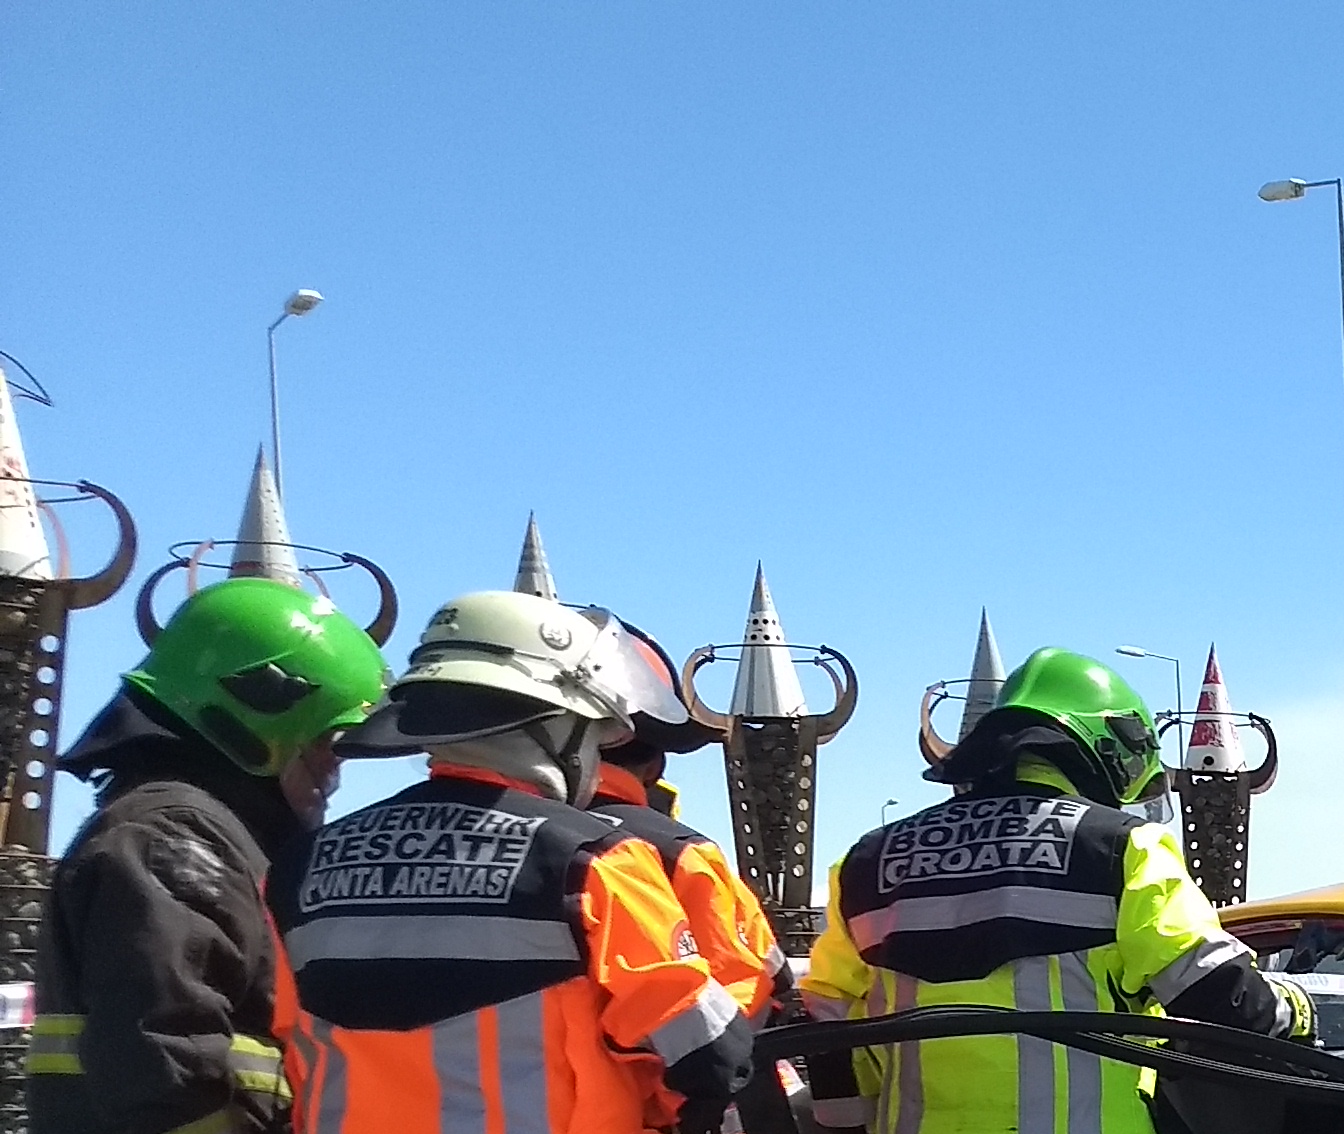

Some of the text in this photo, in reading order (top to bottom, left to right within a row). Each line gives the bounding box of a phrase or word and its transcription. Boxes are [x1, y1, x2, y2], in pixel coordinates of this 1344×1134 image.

[896, 799, 1079, 832] RESCATE
[314, 832, 528, 868] RESCATE
[887, 818, 1066, 854] BOMBA
[885, 842, 1062, 884] CROATA
[304, 866, 508, 904] PUNTA ARENAS
